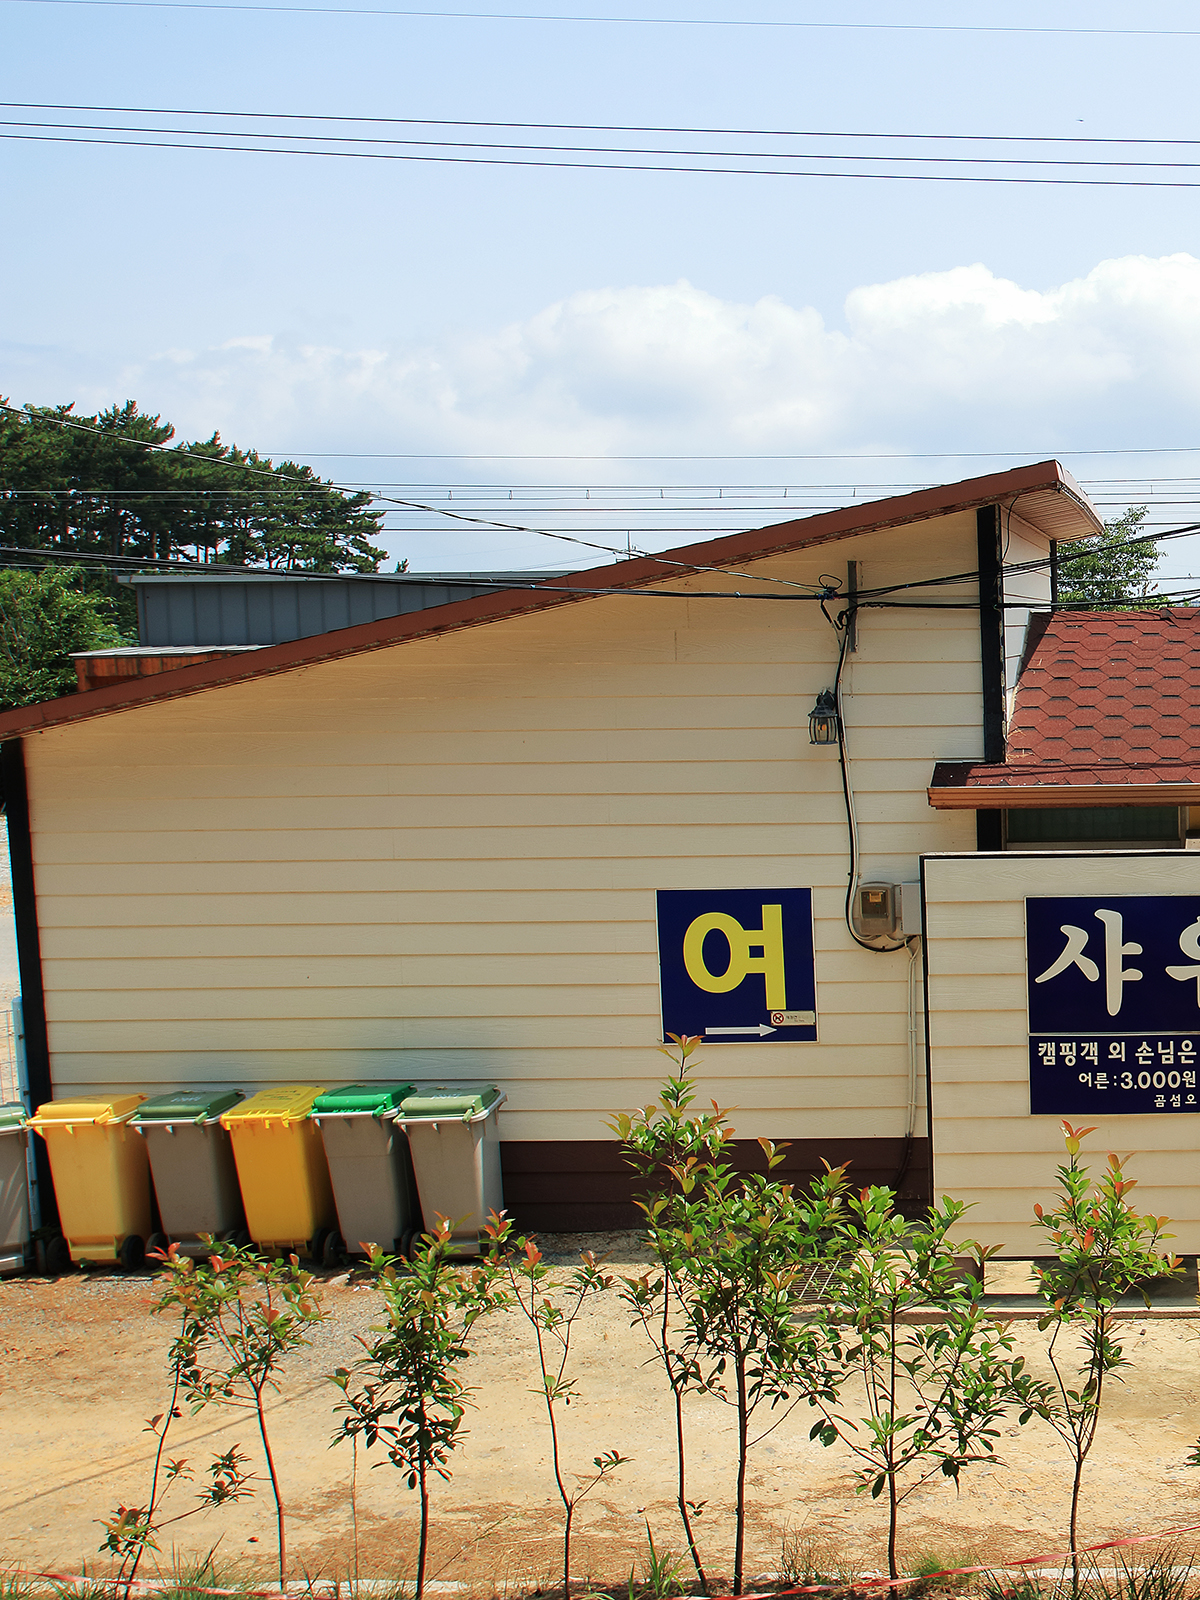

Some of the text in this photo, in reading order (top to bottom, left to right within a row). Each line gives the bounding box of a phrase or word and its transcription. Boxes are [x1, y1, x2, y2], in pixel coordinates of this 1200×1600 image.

[683, 904, 786, 1010] 여
[1038, 1042, 1099, 1066] 캠핑객
[1108, 1041, 1126, 1062] 외
[1135, 1040, 1197, 1065] 손님은
